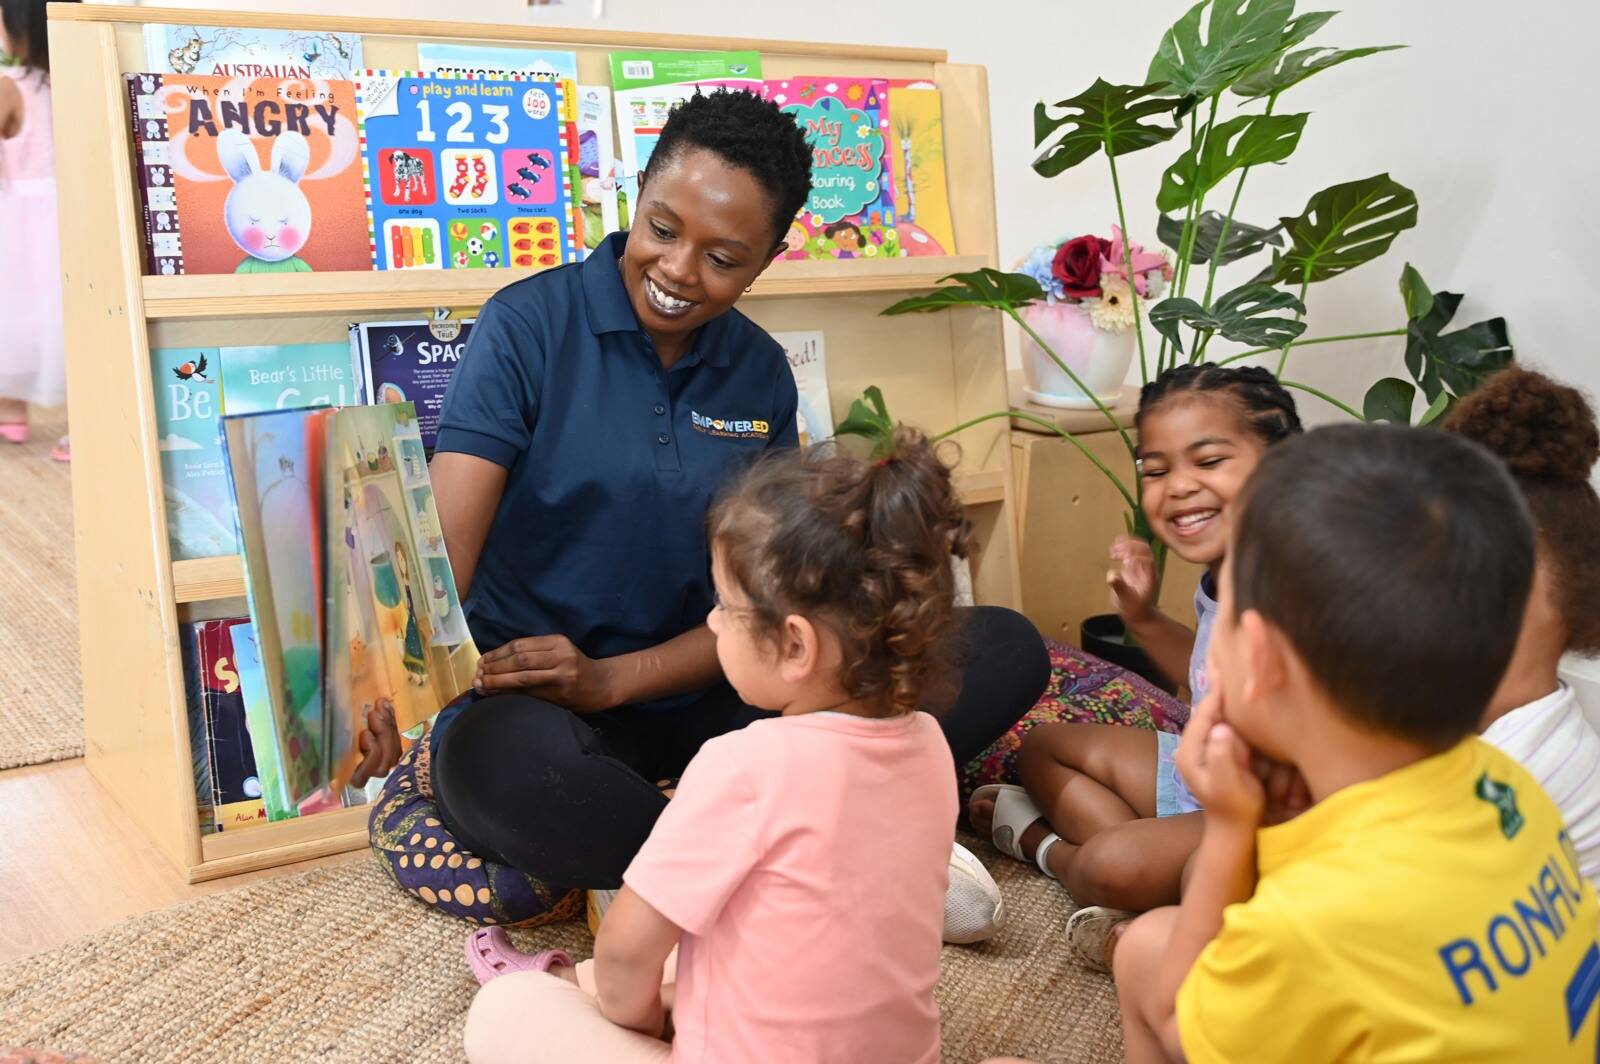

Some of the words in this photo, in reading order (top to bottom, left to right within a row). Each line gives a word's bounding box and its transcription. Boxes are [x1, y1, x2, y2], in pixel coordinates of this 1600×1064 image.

[212, 63, 311, 79] AUSTRALIAN
[187, 86, 230, 96] When
[243, 88, 265, 97] I'm
[276, 88, 335, 103] Feeling
[423, 81, 451, 99] play
[455, 83, 478, 96] and
[480, 83, 513, 97] learn
[527, 97, 546, 109] 100
[188, 99, 340, 137] ANGRY
[415, 99, 436, 142] 1
[445, 101, 475, 143] 2
[482, 103, 510, 145] 3
[804, 116, 842, 145] My
[812, 143, 874, 172] ncess
[811, 173, 856, 191] louring
[813, 195, 845, 208] Book
[410, 208, 423, 216] dog
[417, 342, 465, 365] SPAC
[249, 365, 297, 385] Bear's
[302, 364, 344, 383] Little
[168, 384, 212, 421] Be
[214, 656, 240, 694] S
[235, 812, 254, 822] Alan
[257, 808, 266, 818] M
